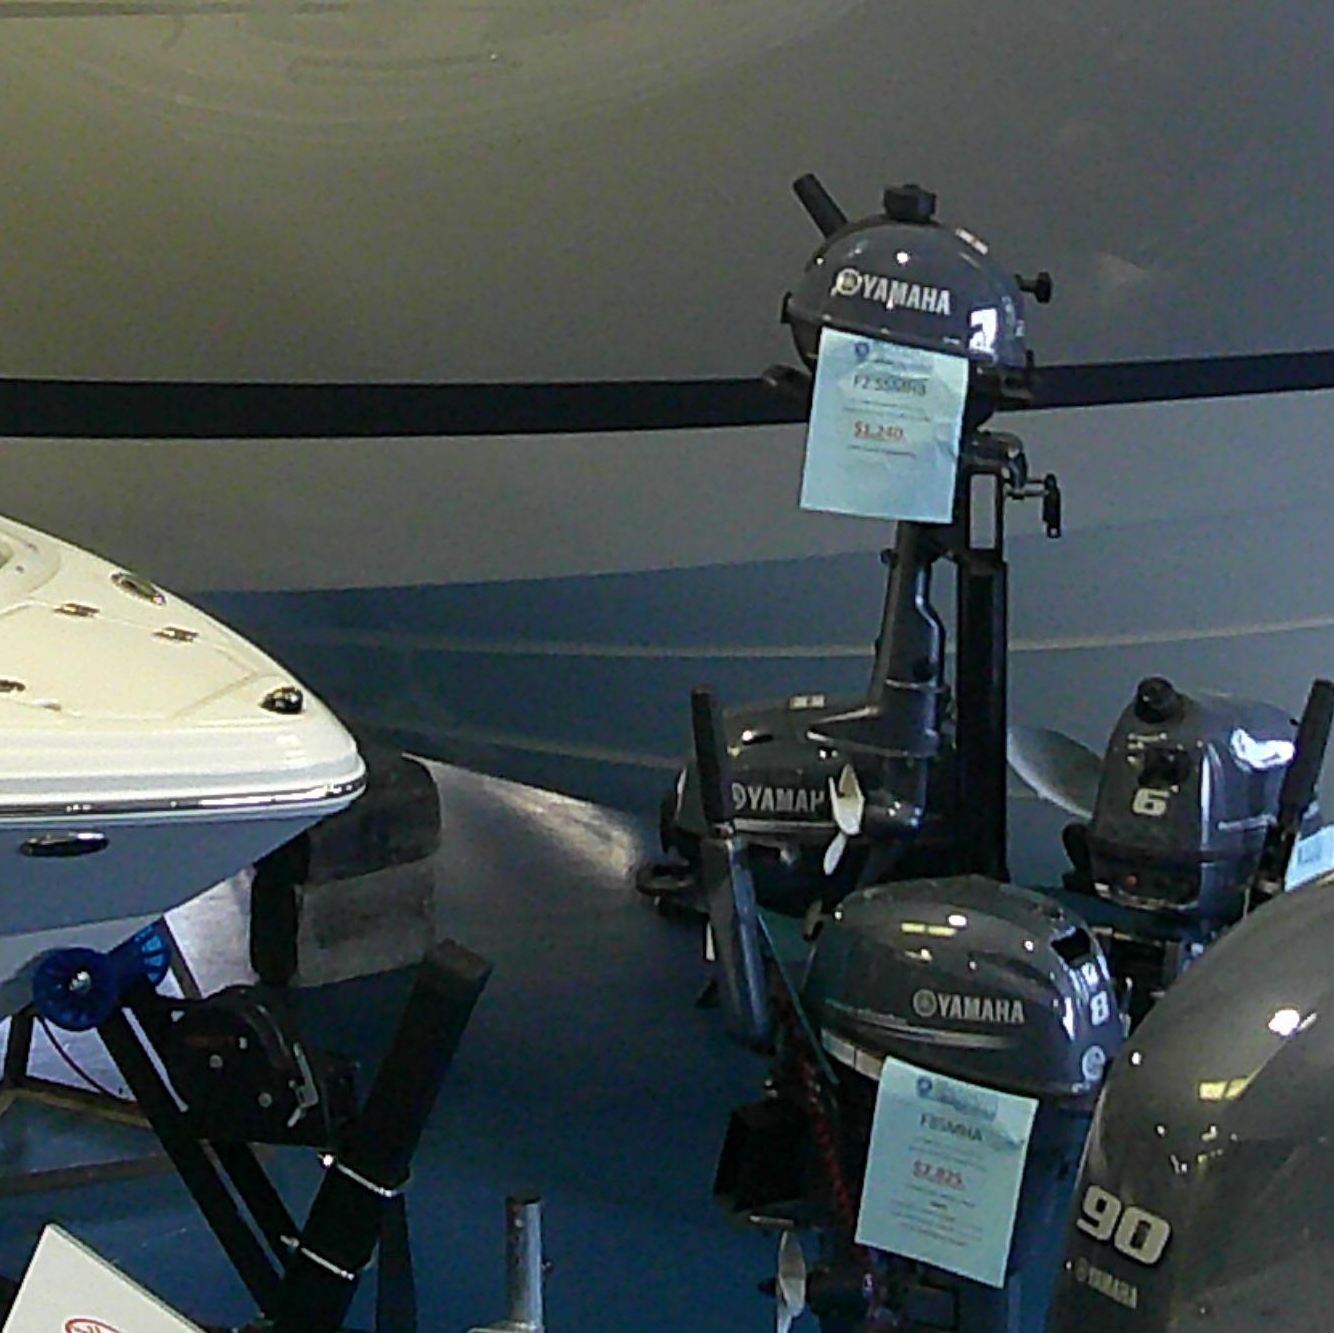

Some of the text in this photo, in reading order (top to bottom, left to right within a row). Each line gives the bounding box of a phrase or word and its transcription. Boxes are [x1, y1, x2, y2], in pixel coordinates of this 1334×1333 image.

[863, 274, 951, 316] YAMAHA
[1132, 787, 1170, 817] 6
[937, 992, 1025, 1023] YAMAHA
[1090, 990, 1110, 1026] 8
[1076, 1185, 1172, 1264] 90
